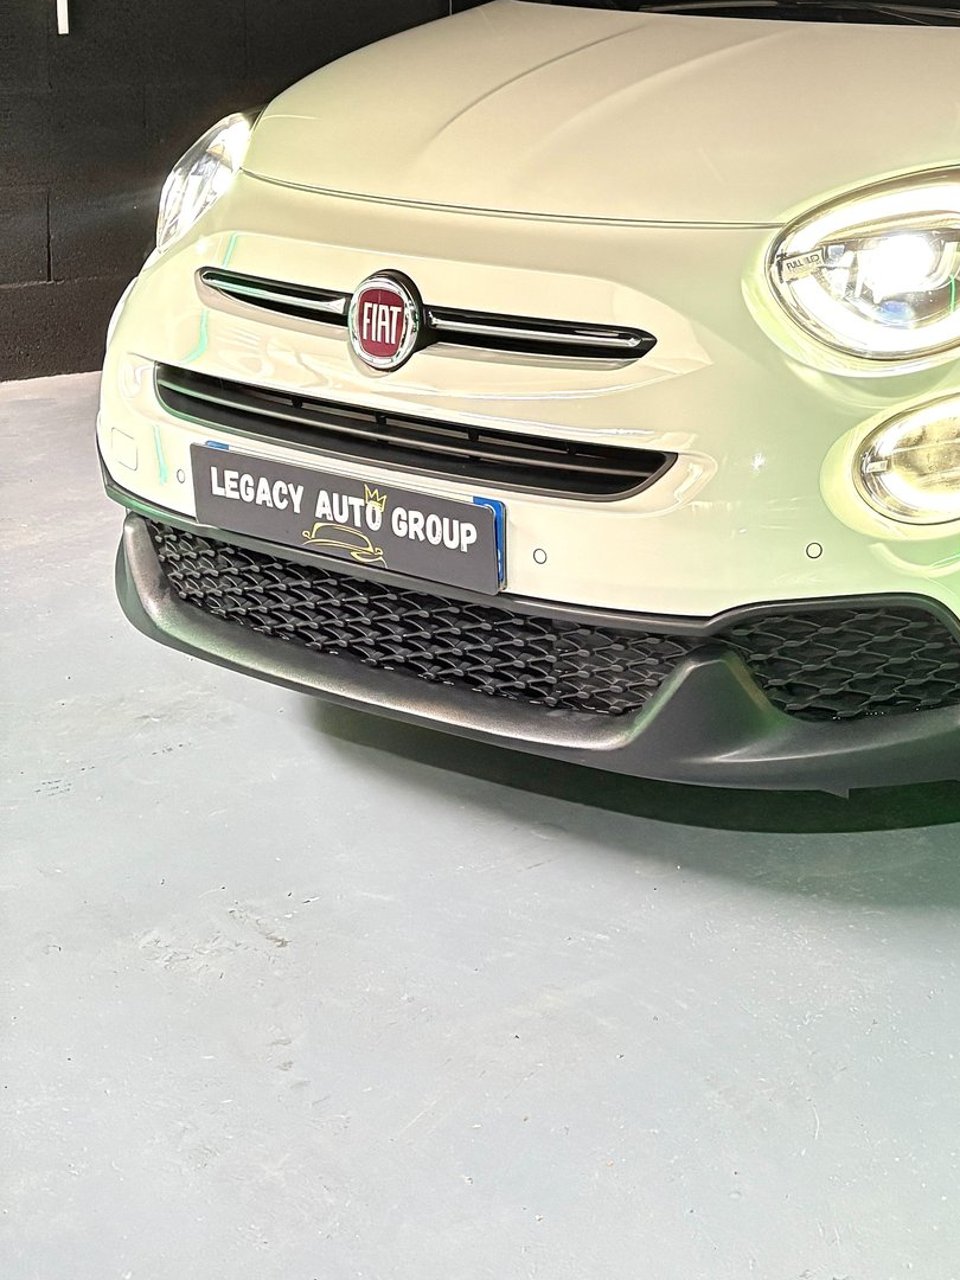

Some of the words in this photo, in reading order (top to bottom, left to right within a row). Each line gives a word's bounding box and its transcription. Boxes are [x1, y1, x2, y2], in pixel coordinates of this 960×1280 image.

[363, 302, 402, 344] FIAT
[211, 466, 304, 513] LEGACY
[315, 490, 383, 532] AUTO
[391, 505, 477, 552] GROUP
